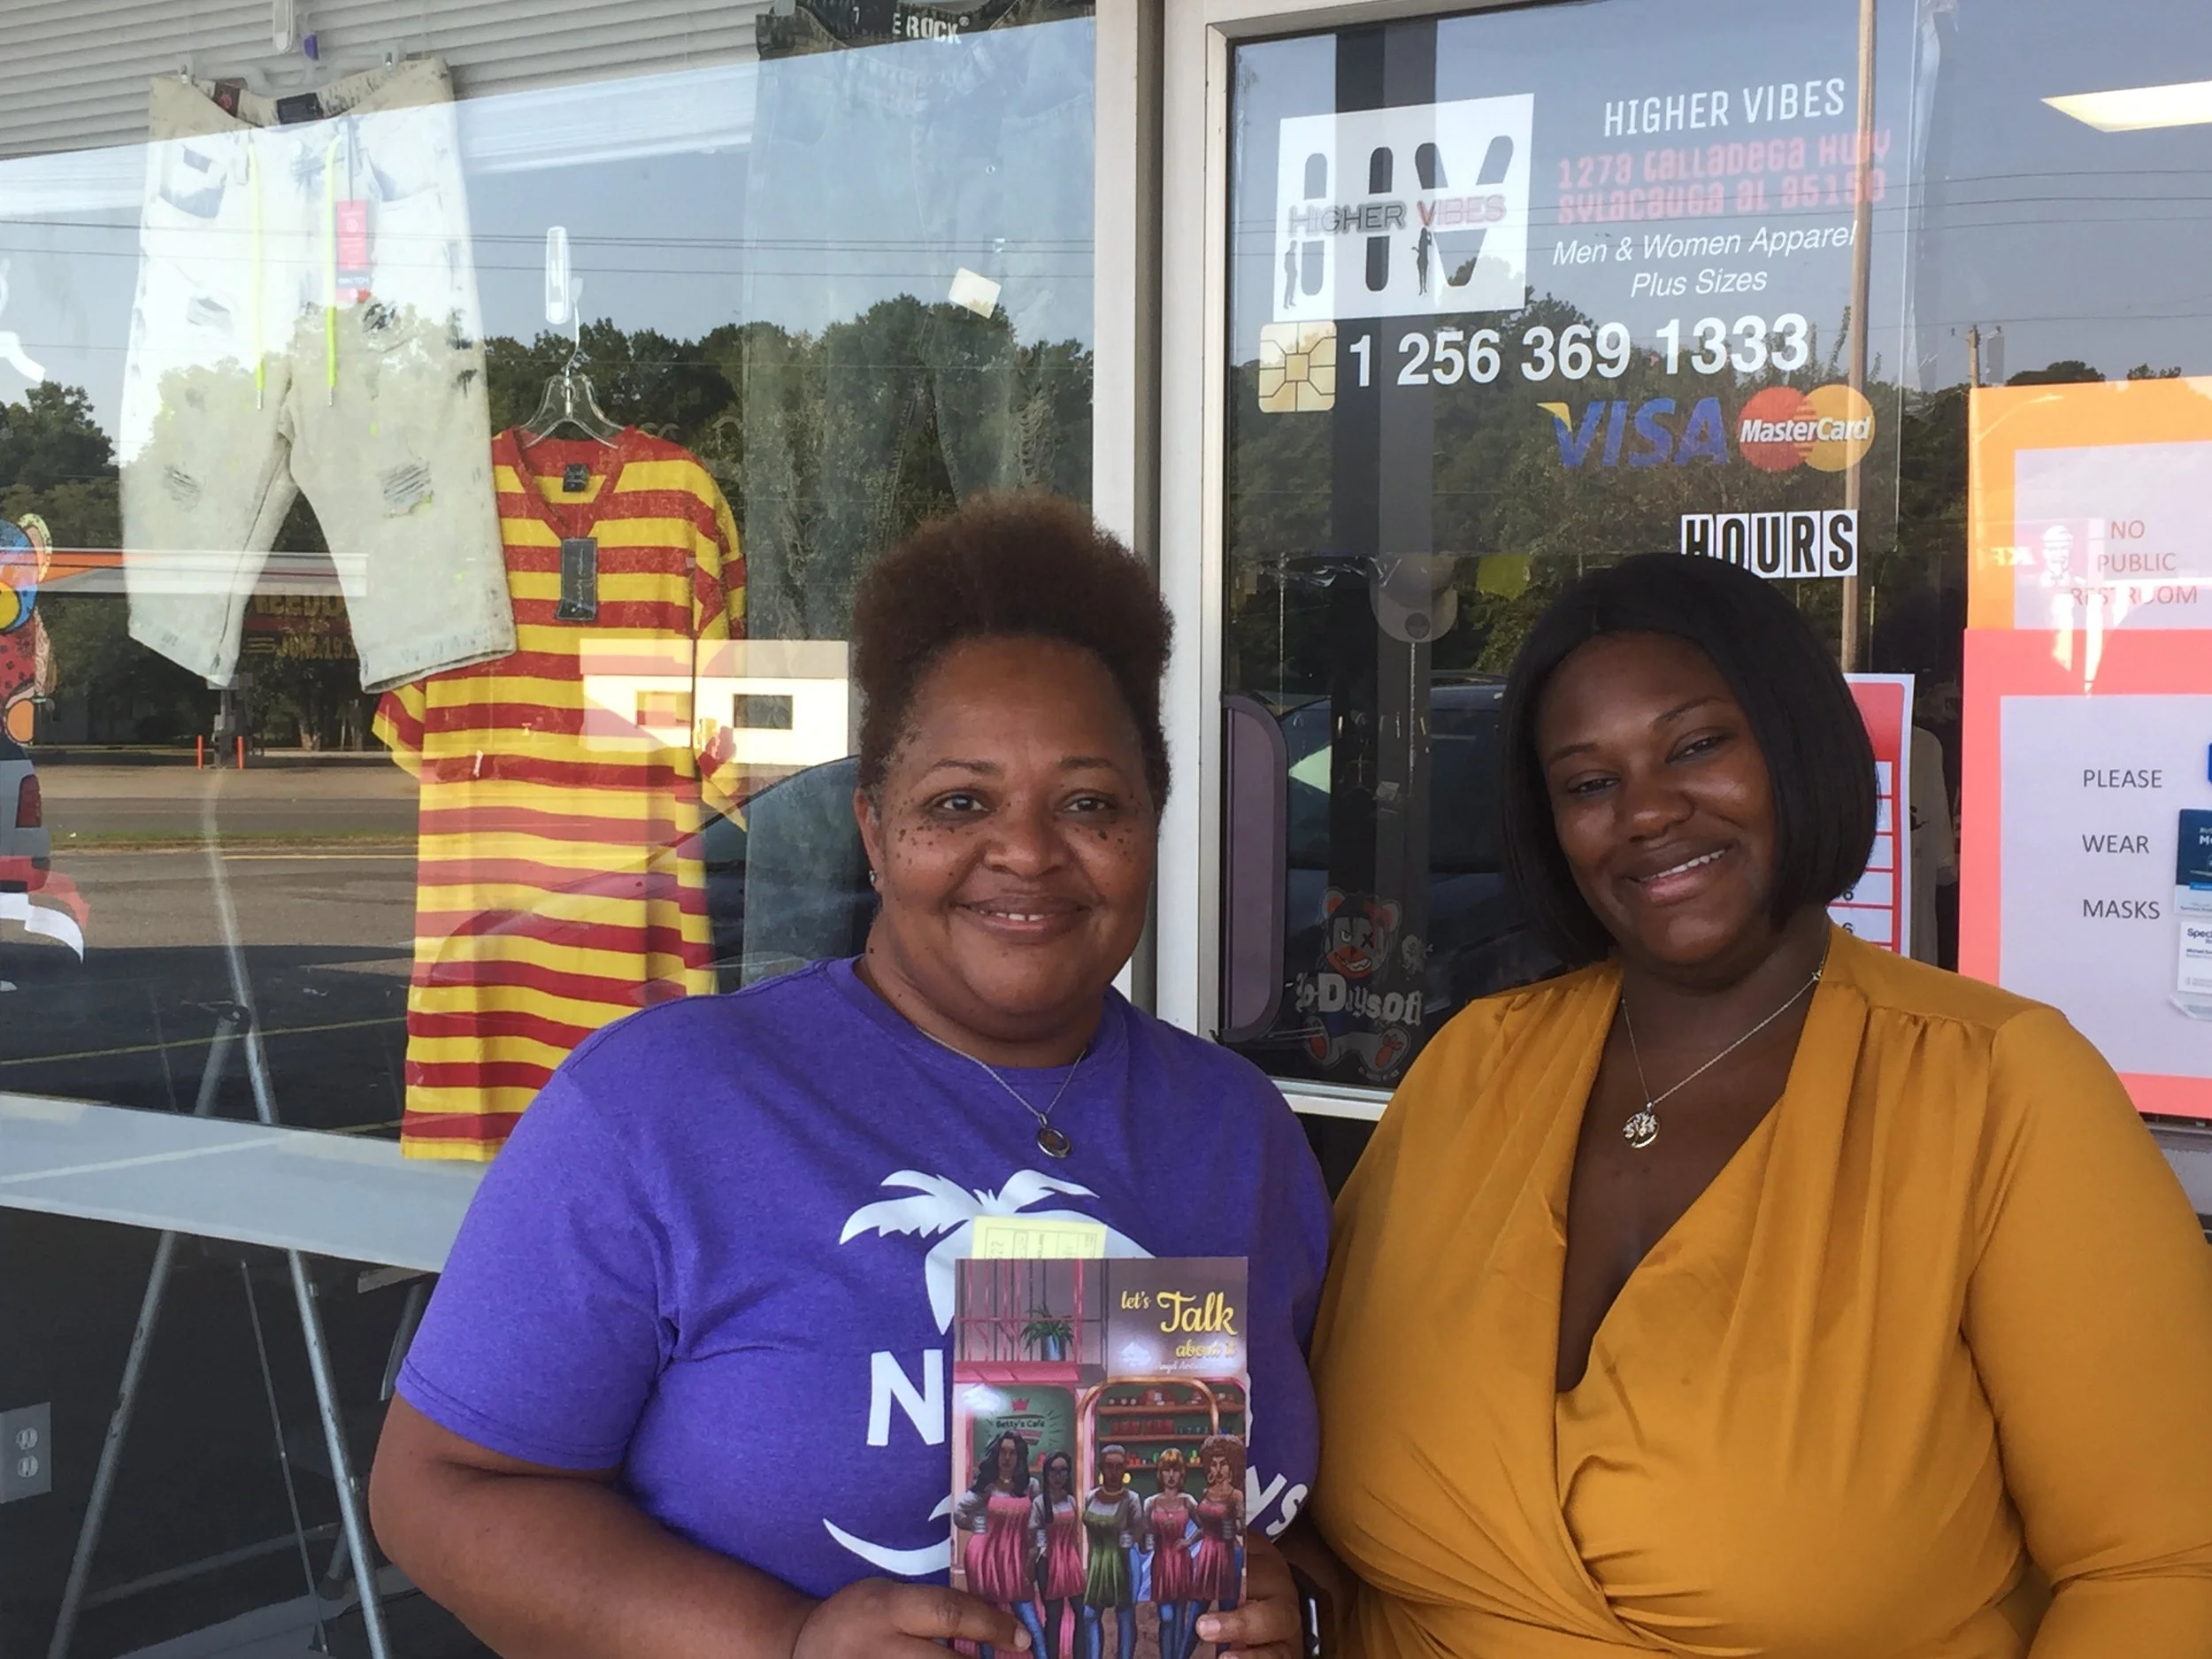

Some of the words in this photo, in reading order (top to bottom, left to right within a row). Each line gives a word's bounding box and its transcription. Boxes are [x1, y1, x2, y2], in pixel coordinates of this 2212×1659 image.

[1603, 89, 1730, 137] HIGHER
[1743, 78, 1847, 124] VIBES
[1288, 202, 1407, 236] HIGHER
[1417, 194, 1507, 227] VIBES
[1553, 239, 1608, 266] Men
[1615, 236, 1632, 262] &
[1642, 232, 1741, 260] Women
[1748, 219, 1859, 258] Apparel
[1631, 272, 1687, 298] Plus
[1694, 267, 1768, 295] Sizes
[1348, 334, 1372, 388] 1
[1396, 329, 1502, 387] 256
[1520, 322, 1632, 382] 369
[1655, 312, 1809, 375] 1333
[1537, 396, 1730, 468] VISA
[1740, 416, 1872, 443] MasterCard
[1686, 512, 1855, 574] HOURS
[2110, 519, 2146, 540] NO
[2097, 551, 2177, 572] PUBLIC
[2070, 585, 2199, 606] RESROM
[2082, 769, 2163, 789] PLEASE
[2081, 833, 2150, 855] WEAR
[2082, 899, 2162, 921] MASKS
[1121, 1290, 1151, 1310] let's
[1156, 1291, 1238, 1335] Talk
[1175, 1339, 1221, 1359] about
